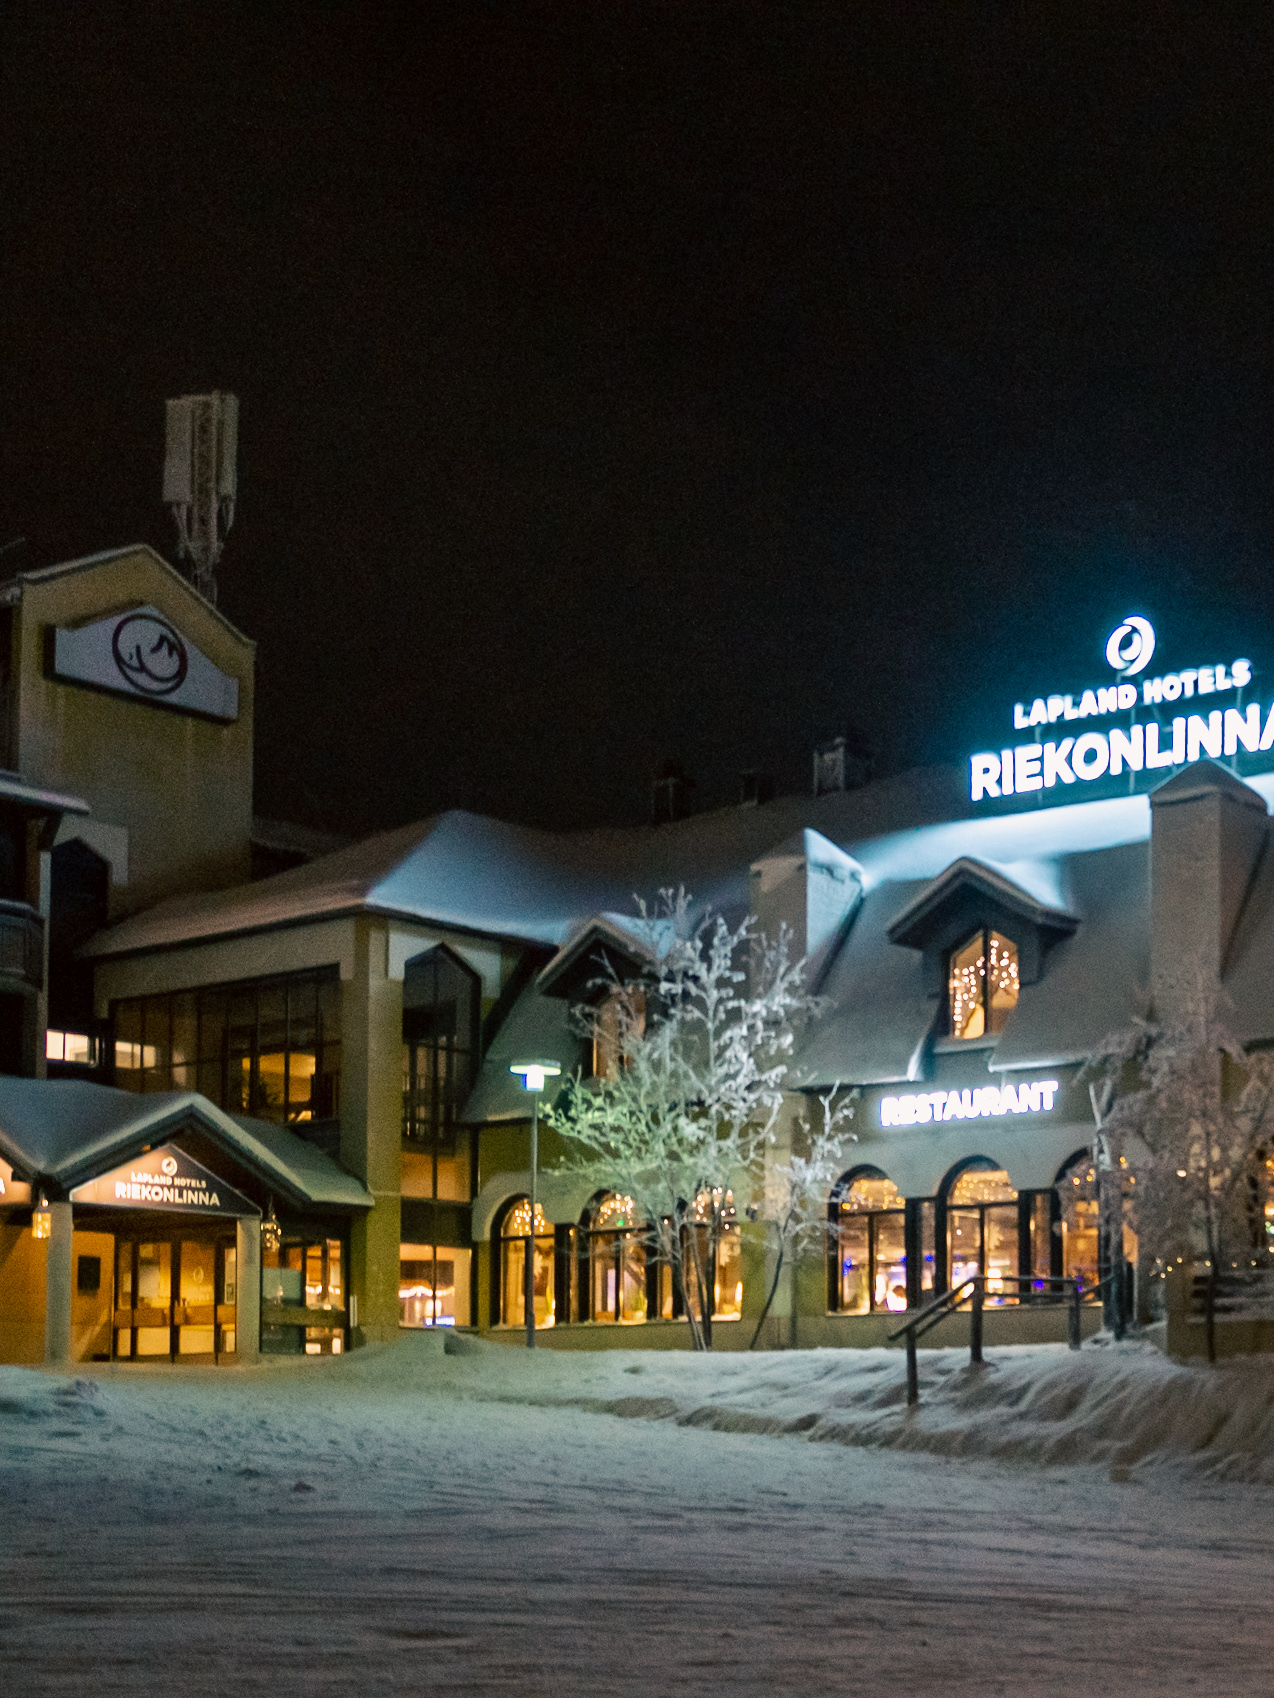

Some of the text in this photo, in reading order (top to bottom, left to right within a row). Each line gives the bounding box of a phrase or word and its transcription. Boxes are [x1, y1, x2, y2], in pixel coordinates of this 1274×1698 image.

[1013, 658, 1252, 729] LAPLAND HOTELS
[880, 1080, 1060, 1127] RESTAURANT
[115, 1181, 220, 1207] RIEKONLINNA
[130, 1171, 207, 1189] LAPLAND HOTELS
